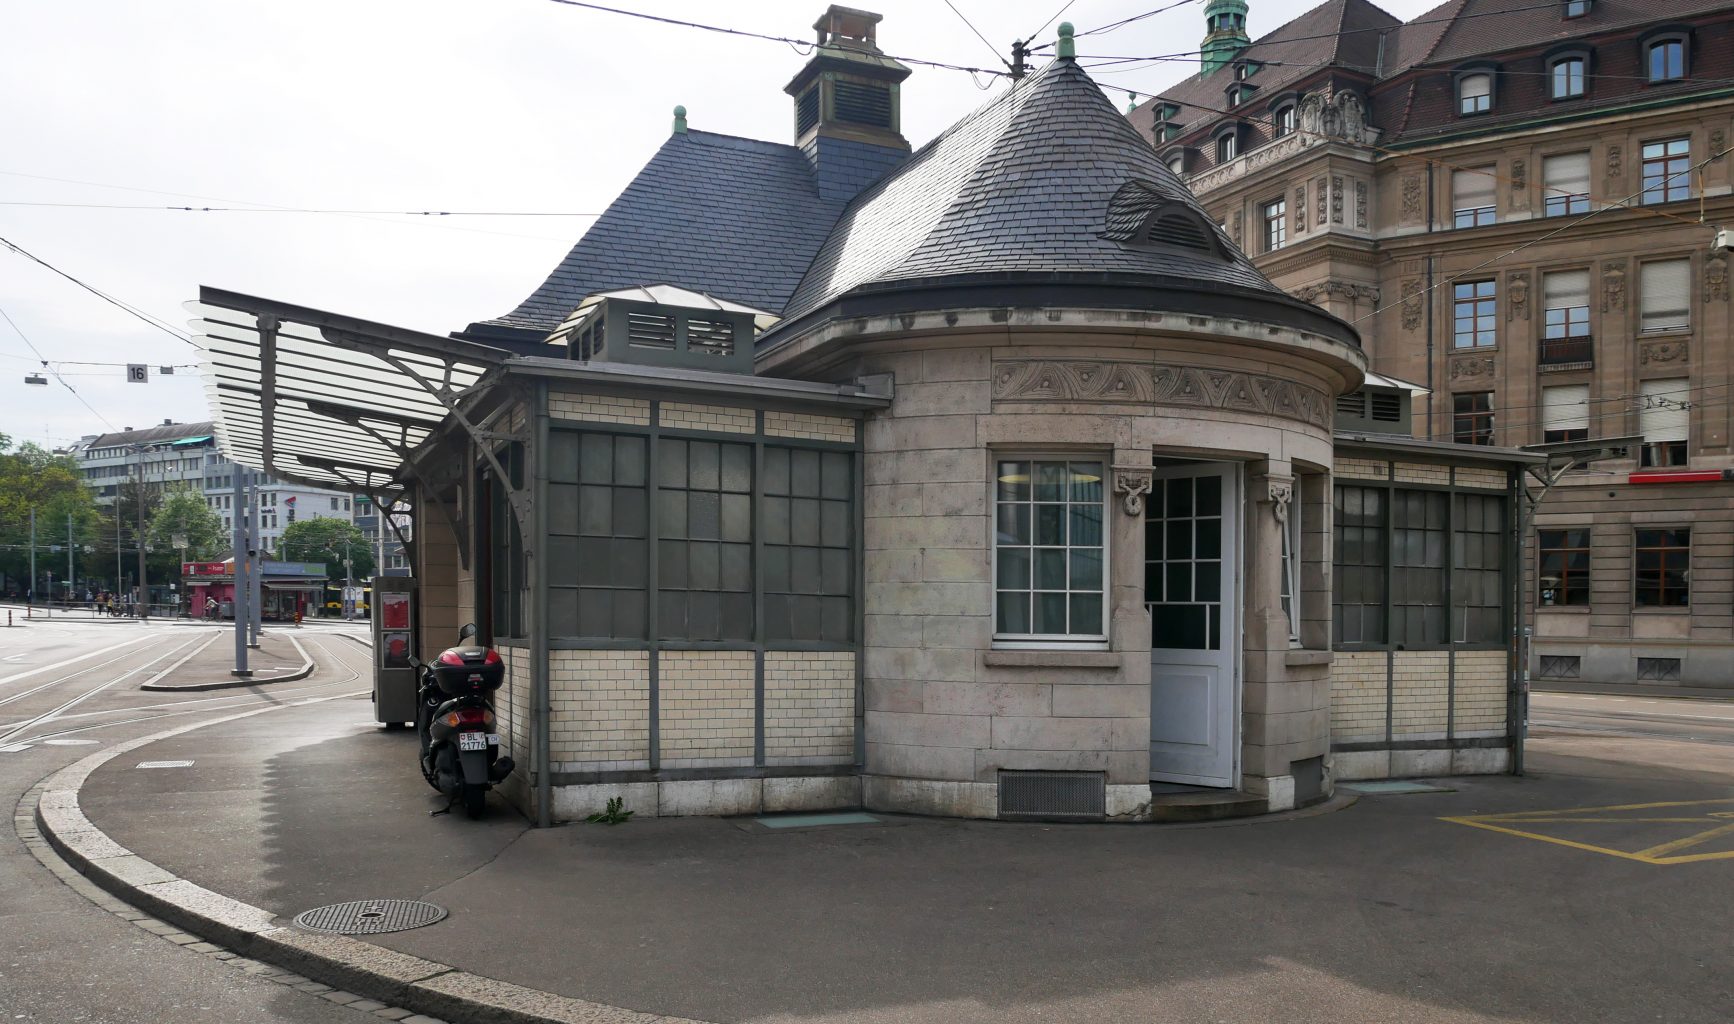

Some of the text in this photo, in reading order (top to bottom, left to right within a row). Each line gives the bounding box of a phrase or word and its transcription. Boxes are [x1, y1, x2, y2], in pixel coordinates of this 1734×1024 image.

[130, 367, 145, 380] 16
[467, 733, 478, 741] BL
[461, 741, 486, 750] 21776
